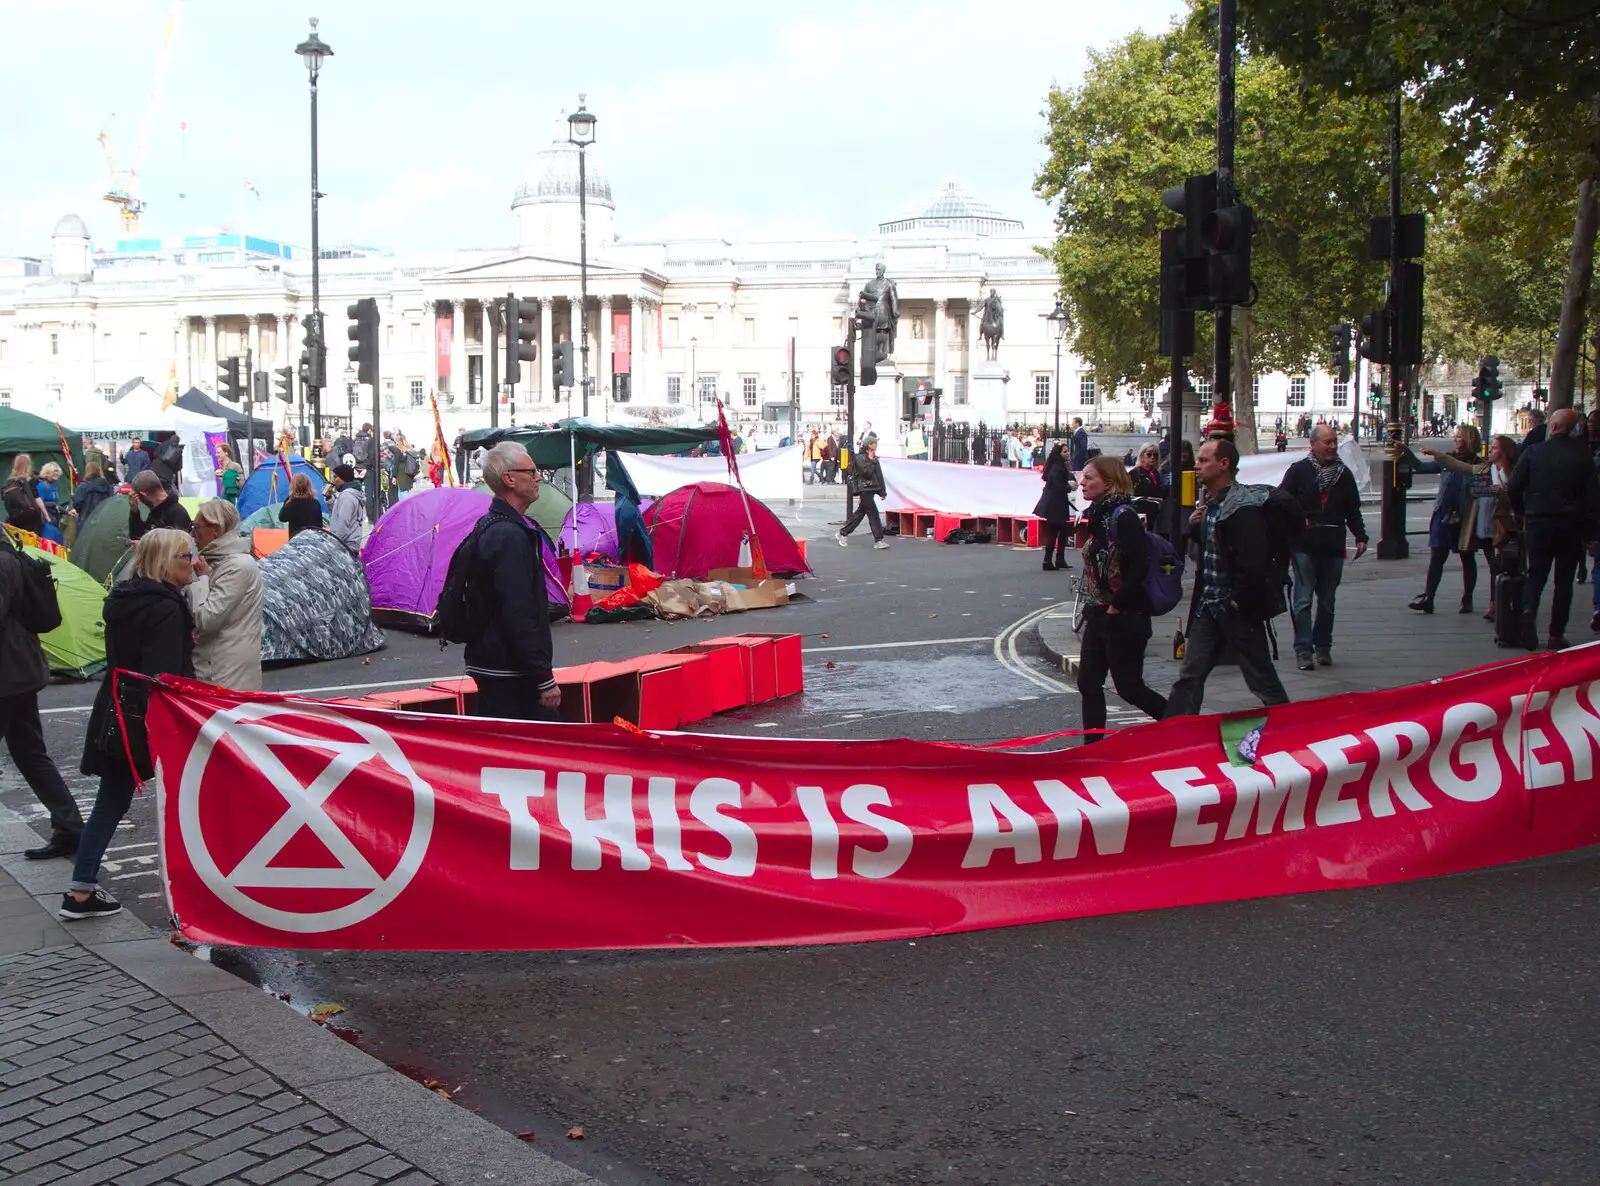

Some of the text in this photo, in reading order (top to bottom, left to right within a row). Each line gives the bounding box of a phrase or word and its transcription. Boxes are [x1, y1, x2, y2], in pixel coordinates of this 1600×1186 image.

[83, 430, 133, 440] WELCOME
[480, 680, 1600, 880] THIS IS AN EMERGEN
